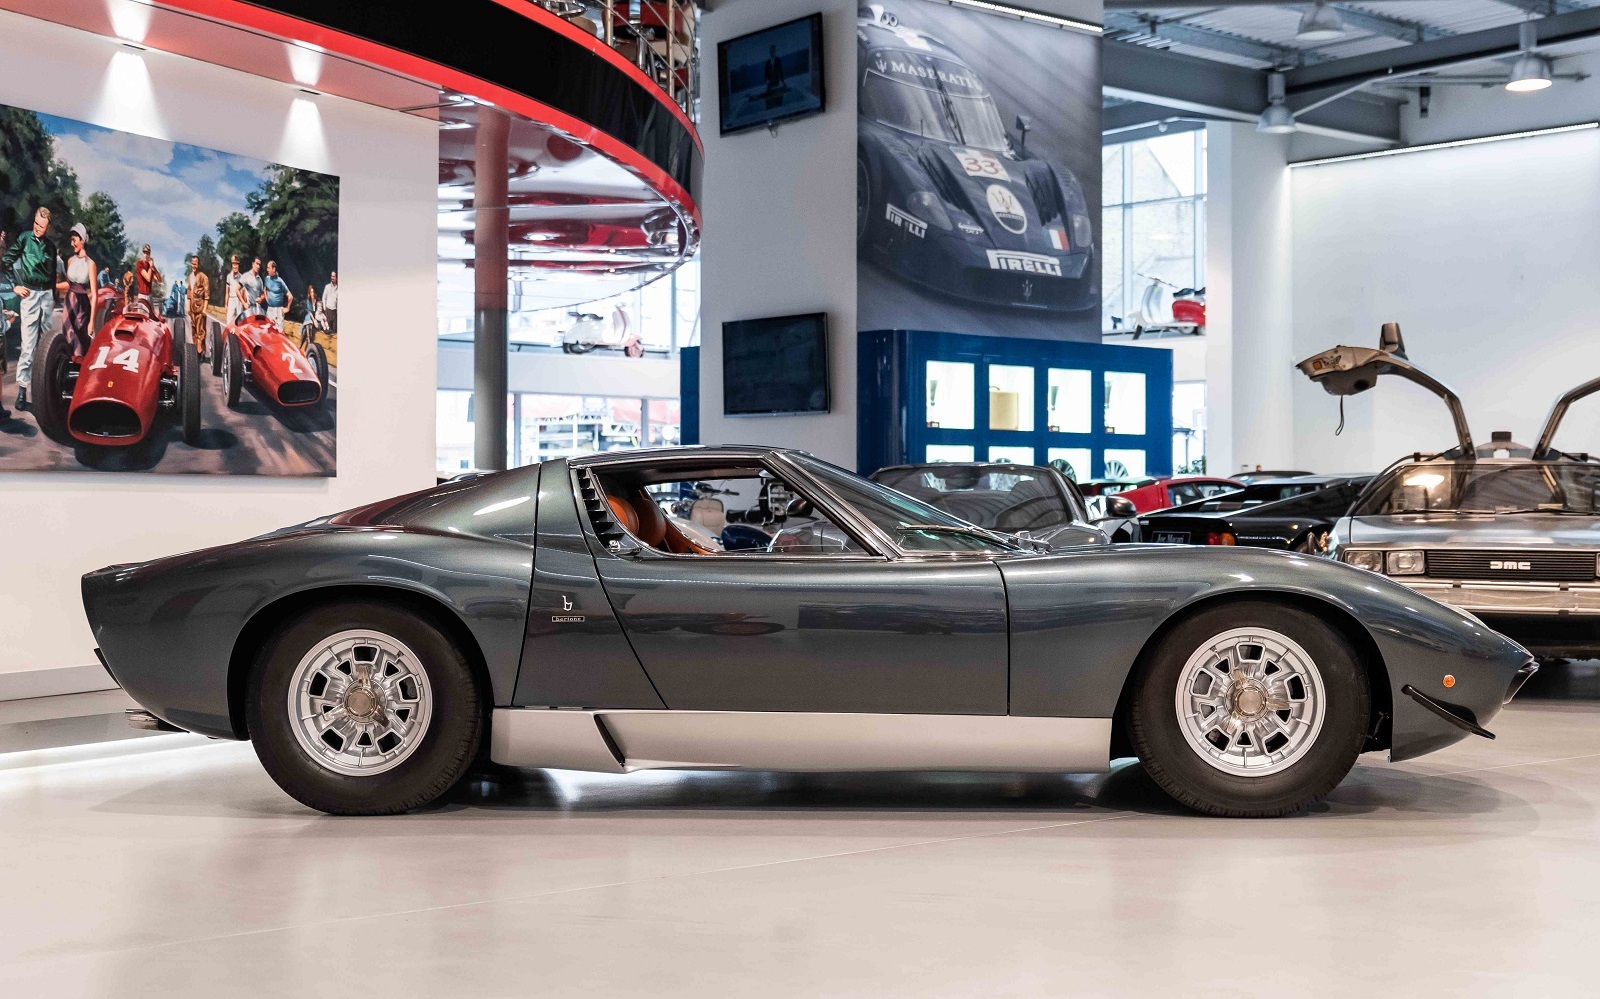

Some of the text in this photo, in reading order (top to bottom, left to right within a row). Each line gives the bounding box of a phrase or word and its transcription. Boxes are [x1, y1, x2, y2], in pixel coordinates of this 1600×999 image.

[891, 60, 973, 89] MASERATI
[965, 158, 999, 174] 33
[986, 249, 1062, 277] PIRELLI
[89, 346, 139, 373] 14
[281, 352, 303, 373] 2
